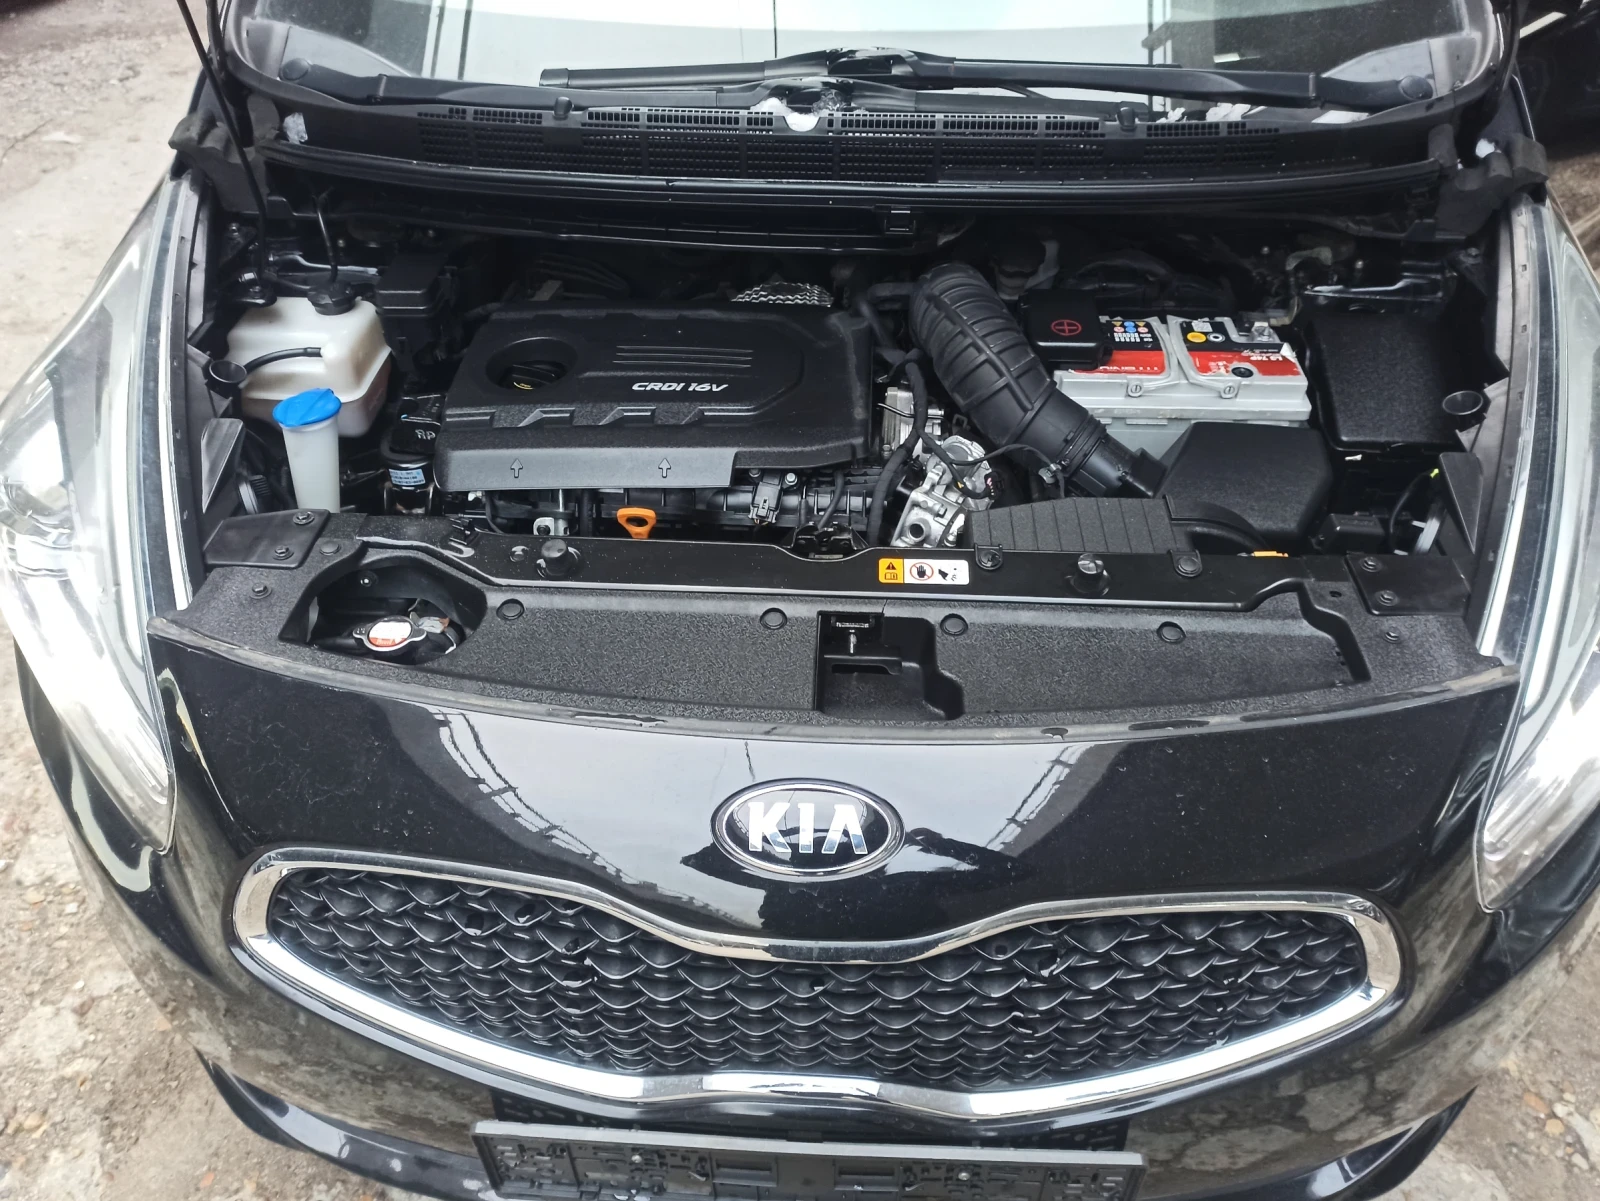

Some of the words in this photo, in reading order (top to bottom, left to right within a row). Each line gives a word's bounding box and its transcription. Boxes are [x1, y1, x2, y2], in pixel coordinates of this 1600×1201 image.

[632, 382, 685, 391] CRDI
[688, 383, 729, 392] 16V
[748, 801, 868, 854] KIA
